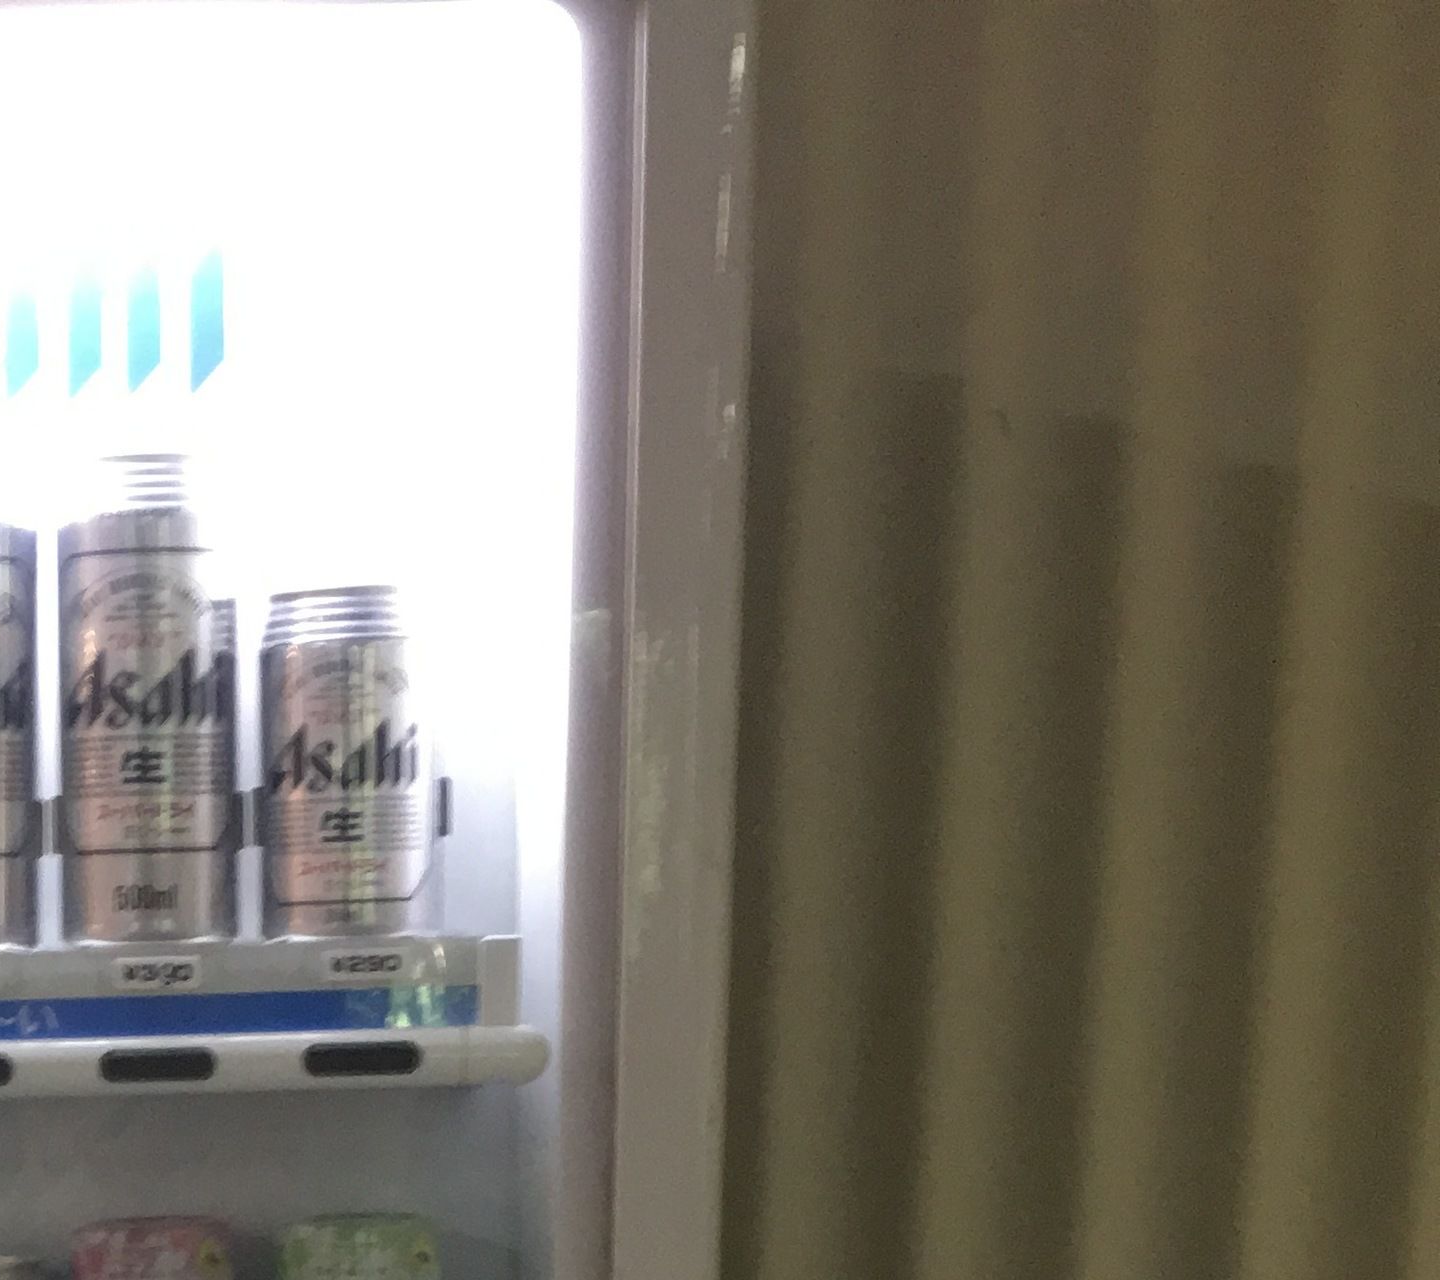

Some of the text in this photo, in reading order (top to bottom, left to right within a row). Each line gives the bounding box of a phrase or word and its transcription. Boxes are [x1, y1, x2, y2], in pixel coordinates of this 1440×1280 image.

[62, 647, 236, 731] Asahi
[119, 745, 170, 785] 生
[264, 716, 419, 796] Asahi
[320, 806, 366, 843] 生
